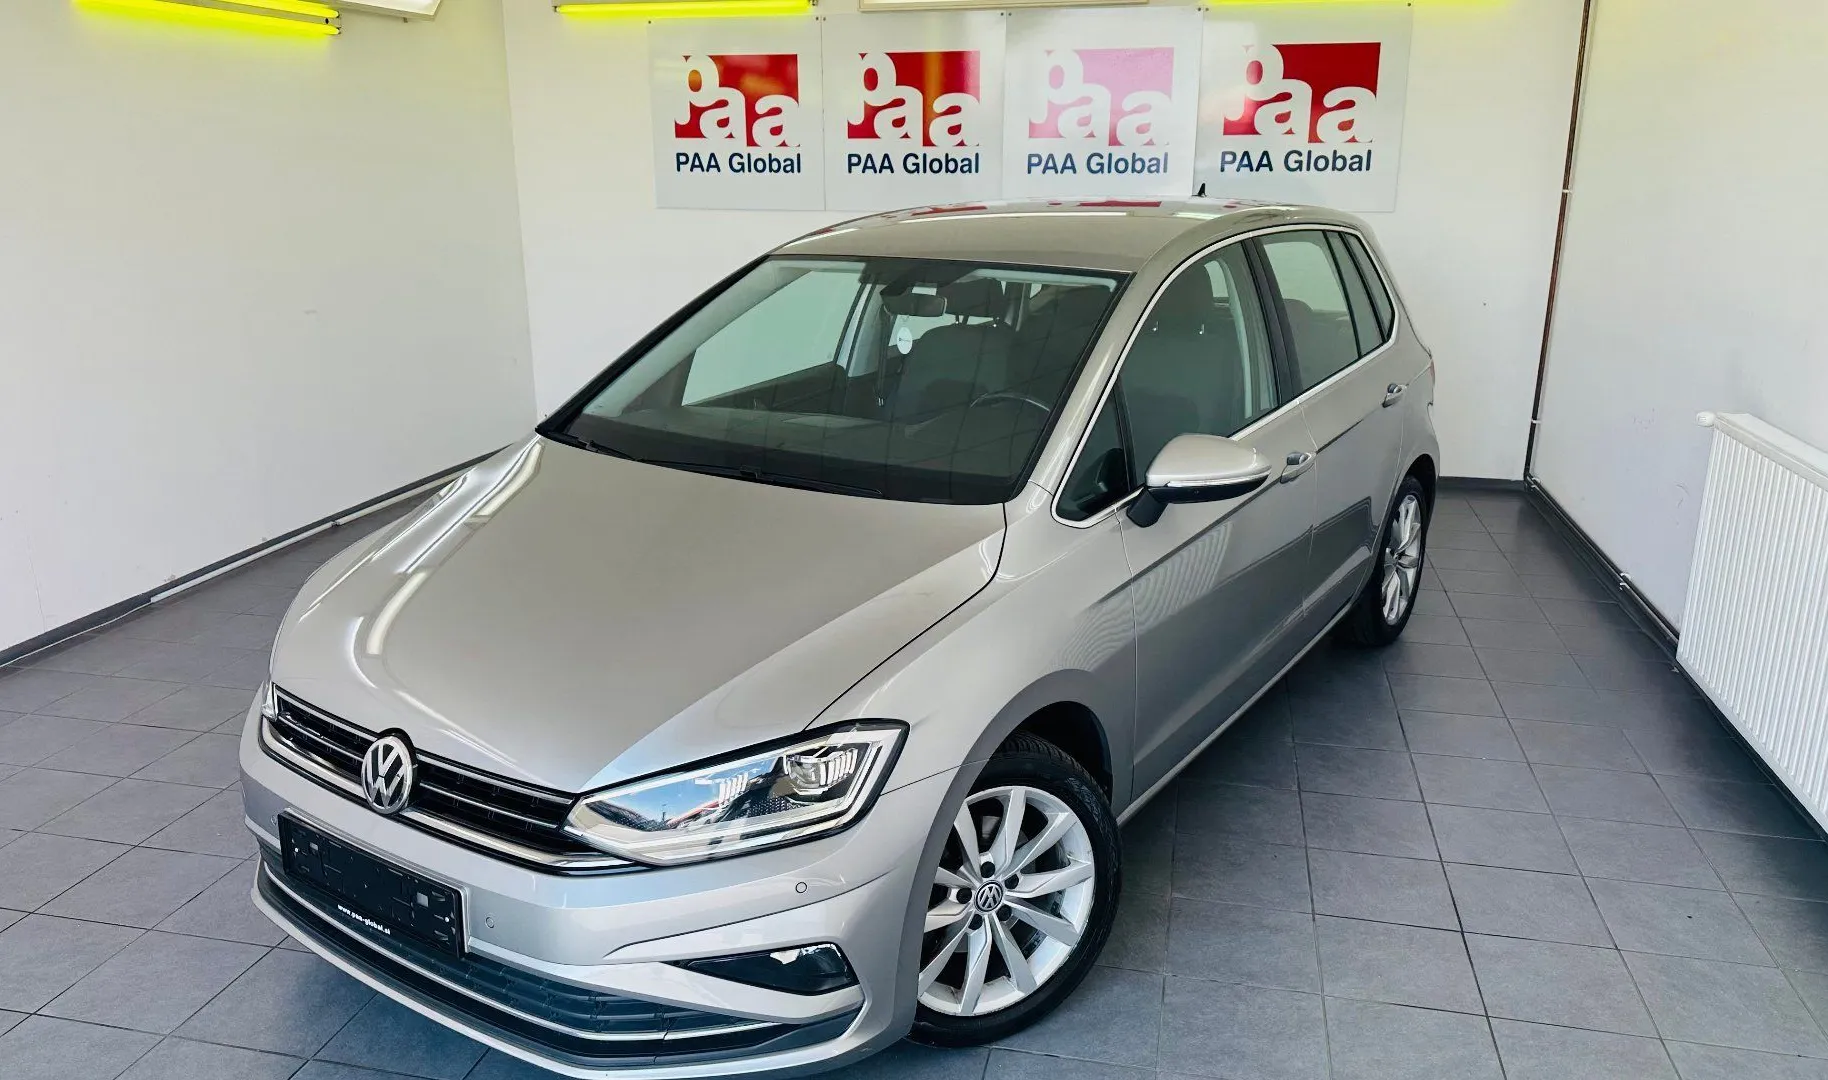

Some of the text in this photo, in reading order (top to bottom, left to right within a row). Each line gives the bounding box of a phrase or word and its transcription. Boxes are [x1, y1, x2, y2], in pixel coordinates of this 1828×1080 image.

[675, 152, 802, 173] PAA Global
[847, 153, 980, 174] PAA Global
[1027, 152, 1169, 174] PAA Global
[1220, 149, 1372, 172] PAA Global
